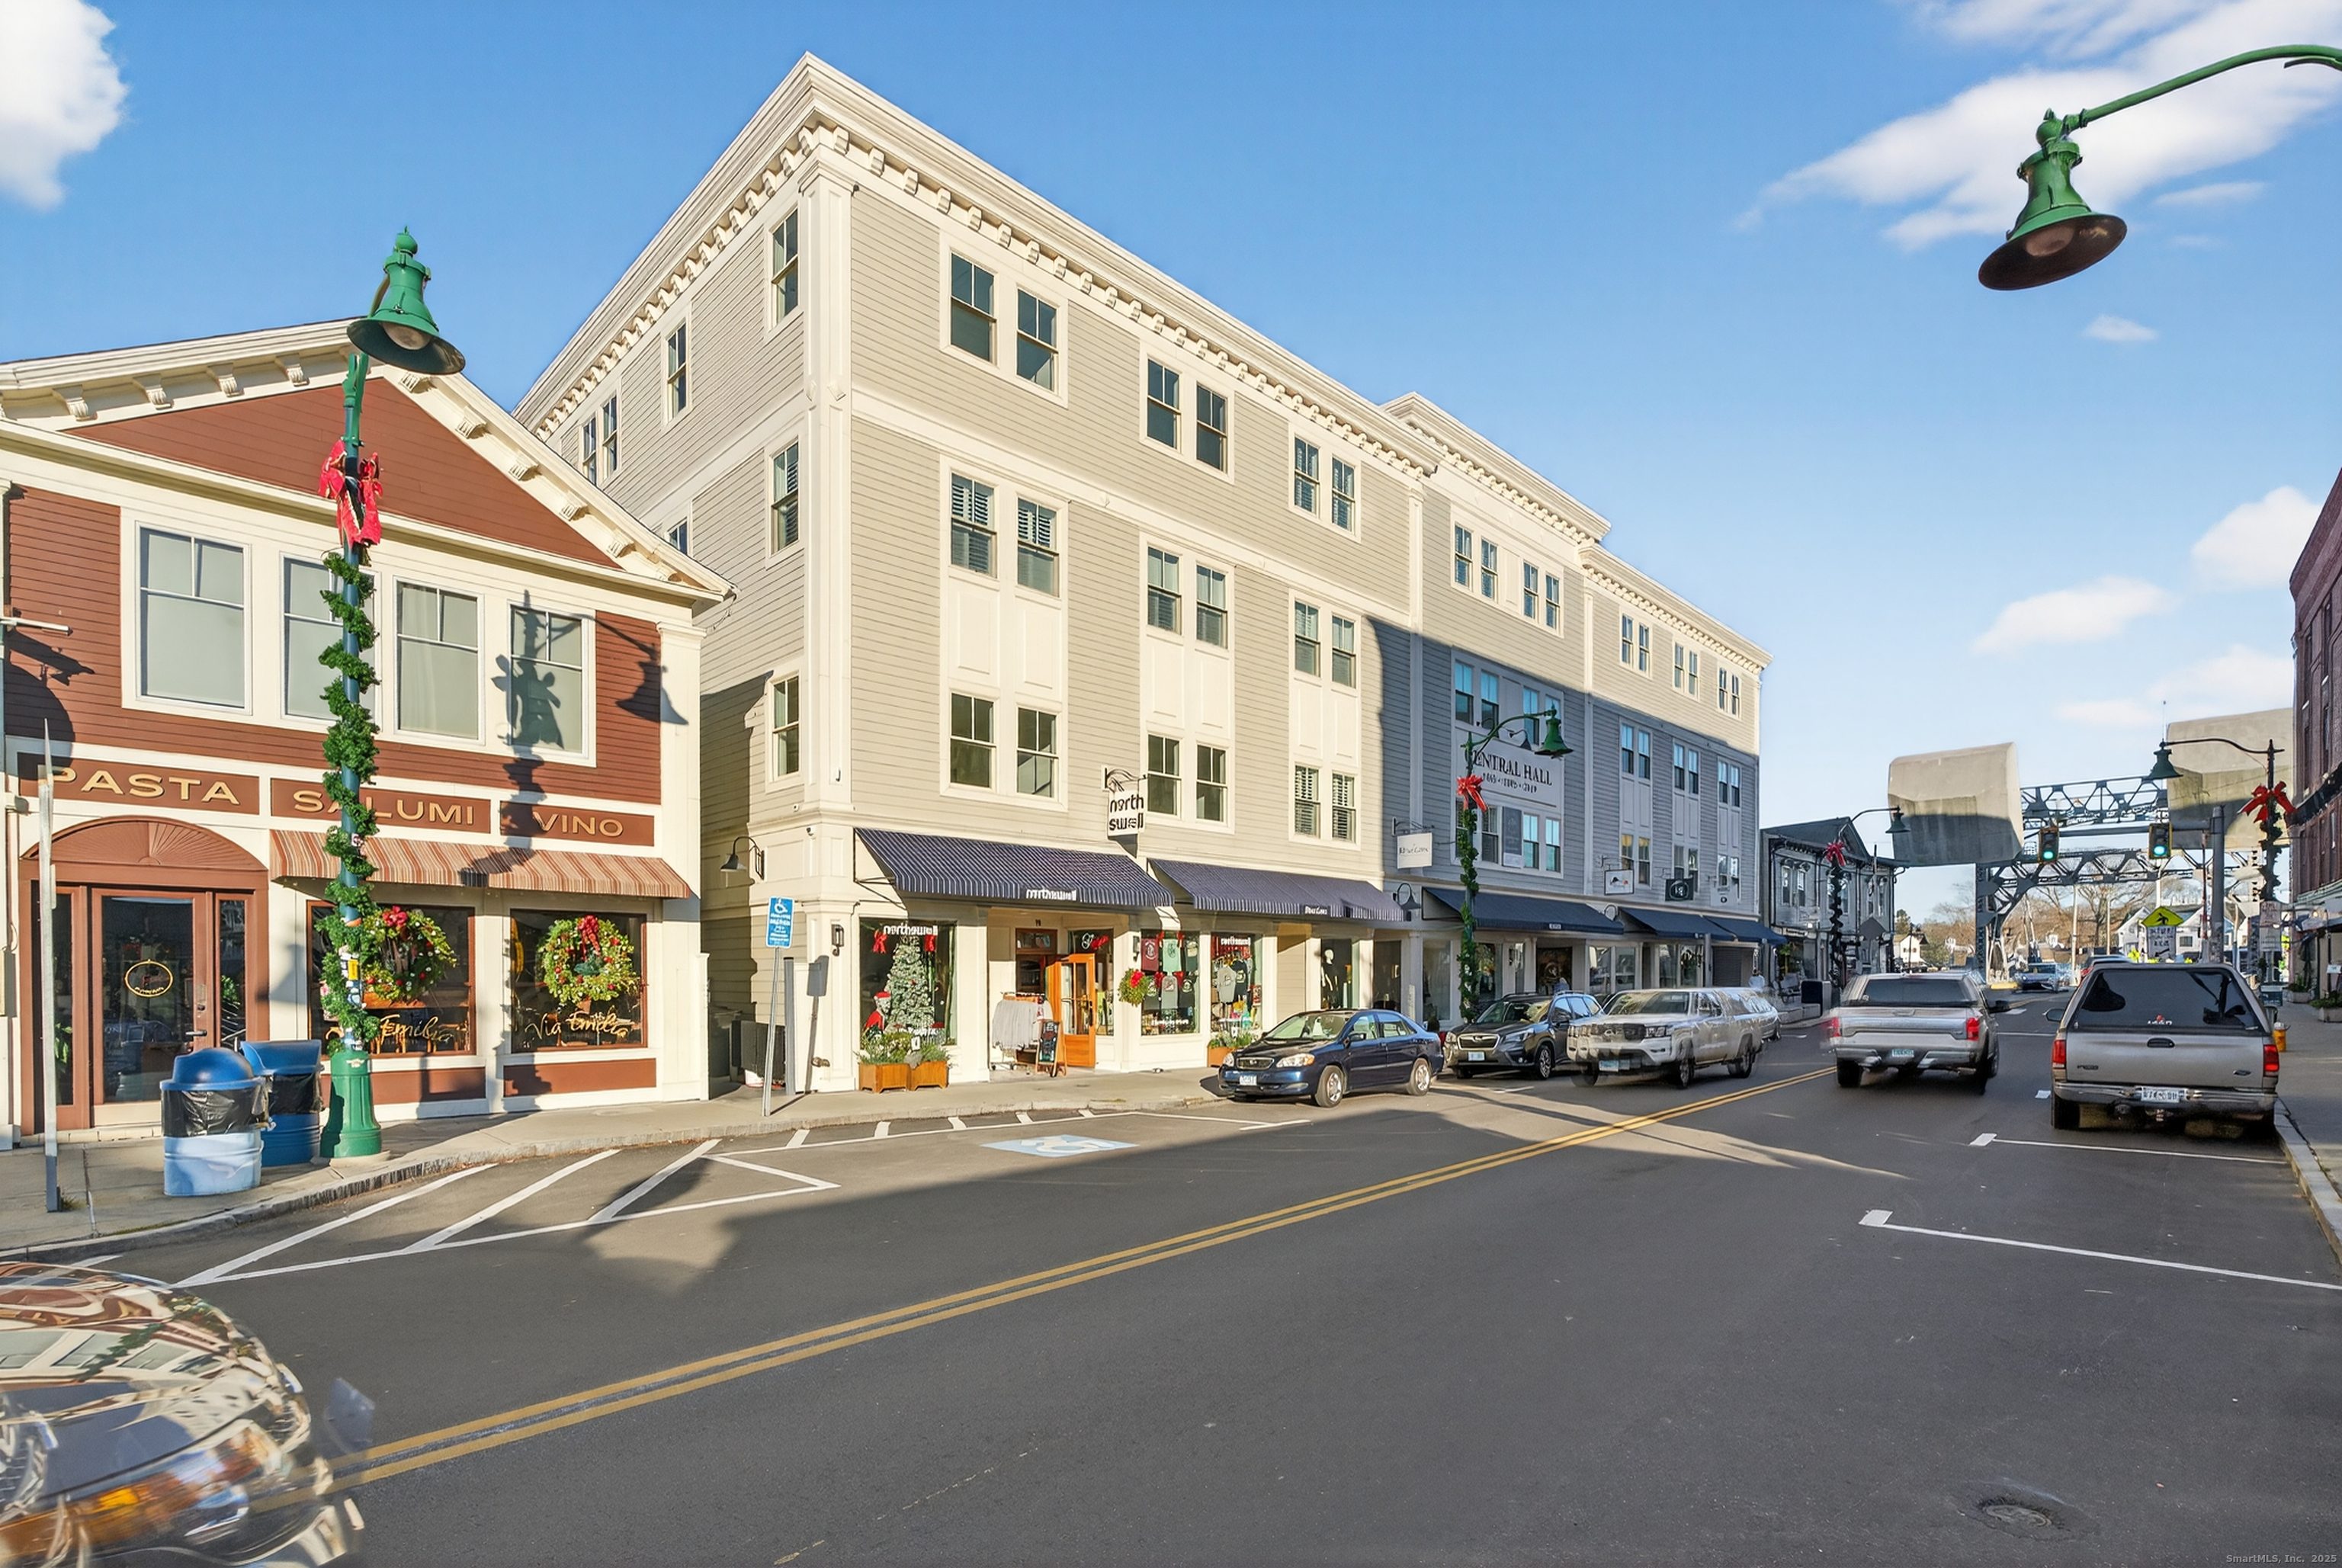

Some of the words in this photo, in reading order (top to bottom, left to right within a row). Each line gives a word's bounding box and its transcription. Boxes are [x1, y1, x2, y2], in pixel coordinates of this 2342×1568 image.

[37, 765, 241, 806] PASTA
[1523, 763, 1552, 786] HALL
[1109, 794, 1144, 813] north
[533, 811, 624, 837] VINO
[1108, 813, 1144, 831] swell
[525, 1013, 562, 1040] Via
